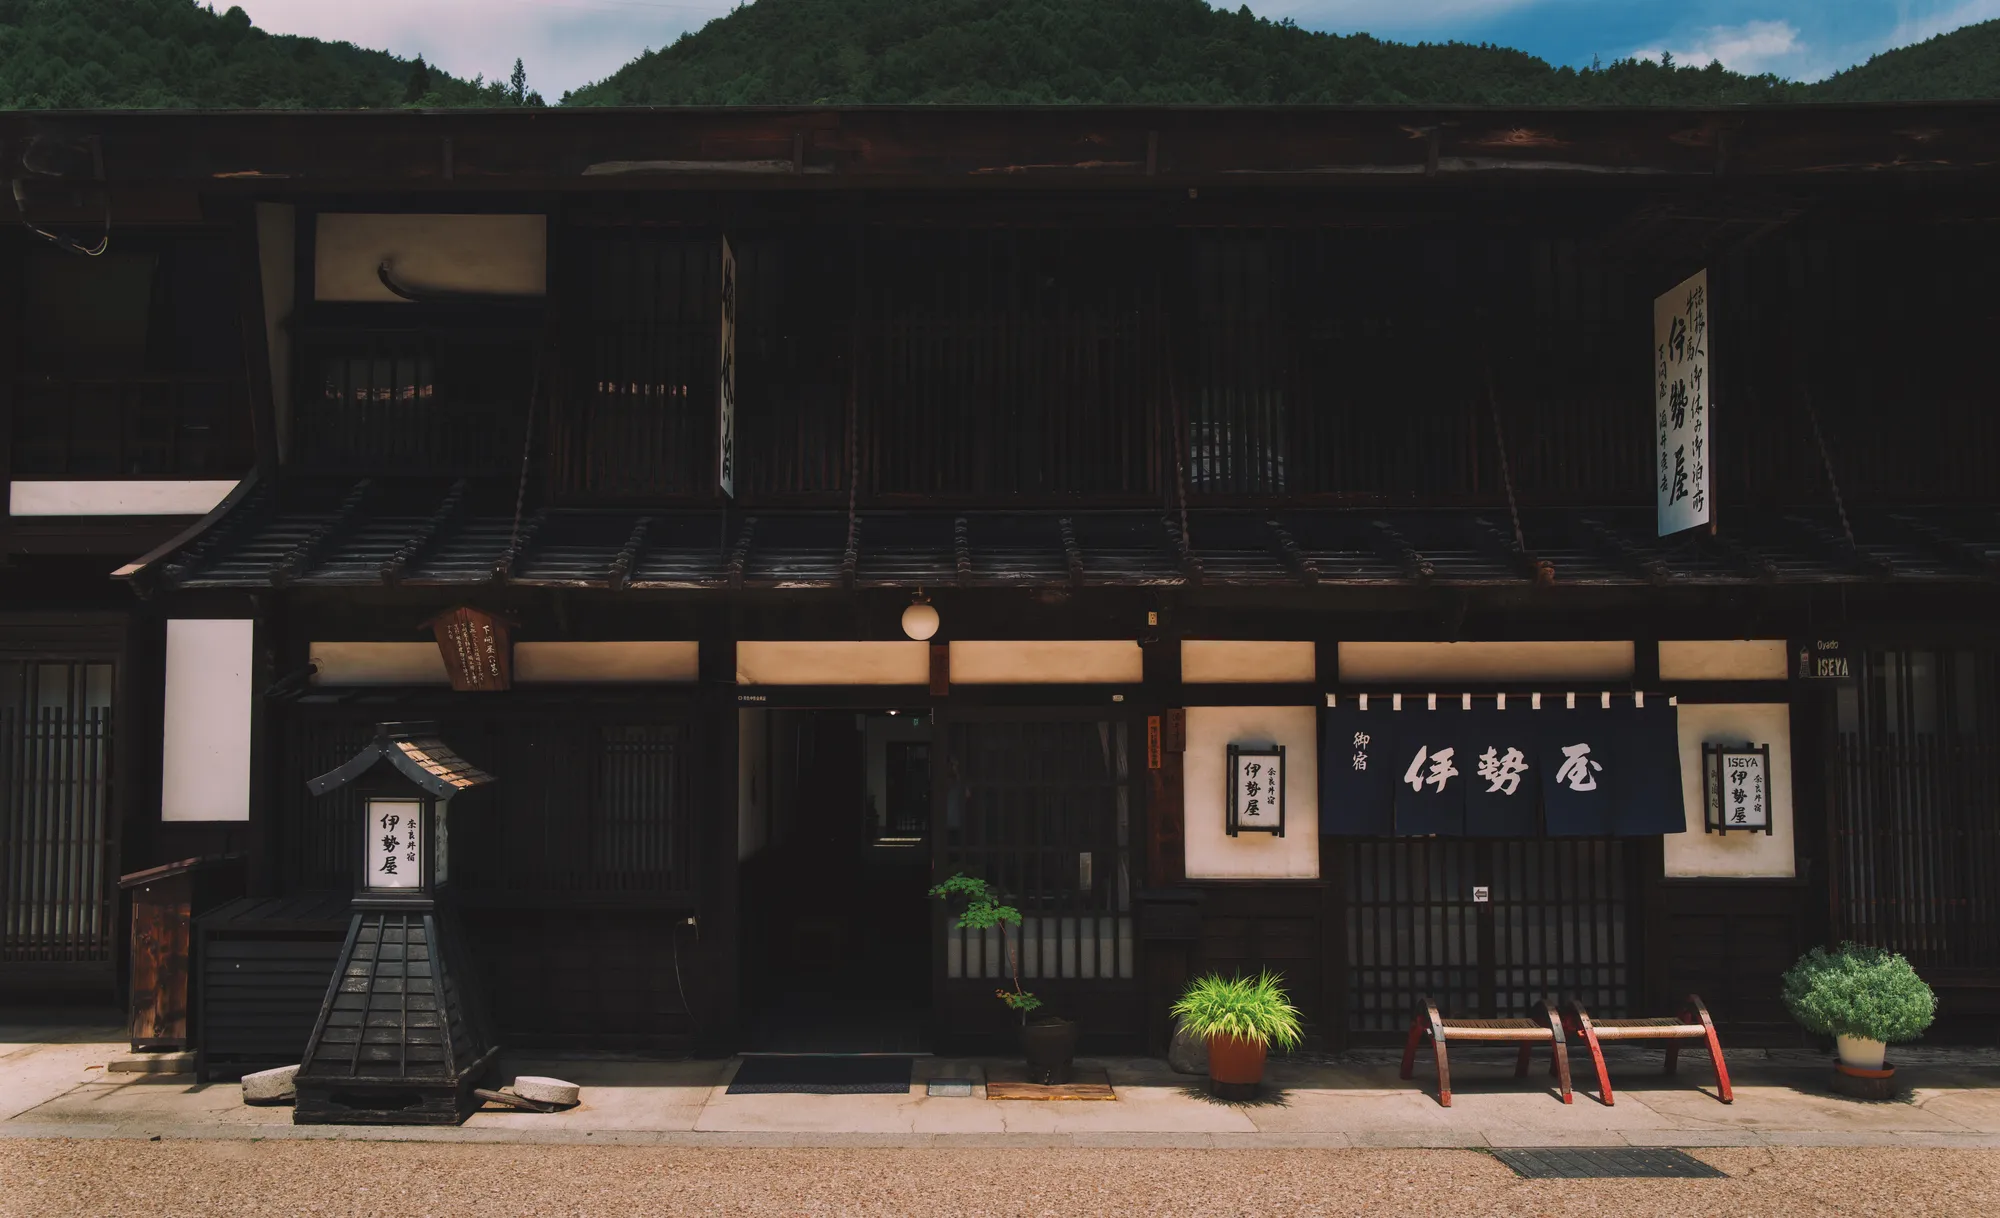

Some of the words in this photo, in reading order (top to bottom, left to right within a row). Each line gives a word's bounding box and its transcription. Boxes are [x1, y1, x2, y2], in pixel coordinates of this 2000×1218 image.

[1669, 315, 1688, 507] 伊勢屋
[1817, 640, 1839, 650] Oyado
[1817, 657, 1849, 676] ISEYA
[1352, 731, 1370, 771] 御宿
[1404, 743, 1603, 795] 伊勢屋
[1728, 757, 1758, 767] ISEYA
[1244, 762, 1261, 816] 伊勢屋
[1267, 767, 1276, 805] 奈良井宿
[1731, 770, 1748, 823] 伊勢屋
[1754, 774, 1762, 812] 奈良井宿
[379, 813, 400, 875] 伊勢屋
[407, 819, 417, 862] 奈良井宿
